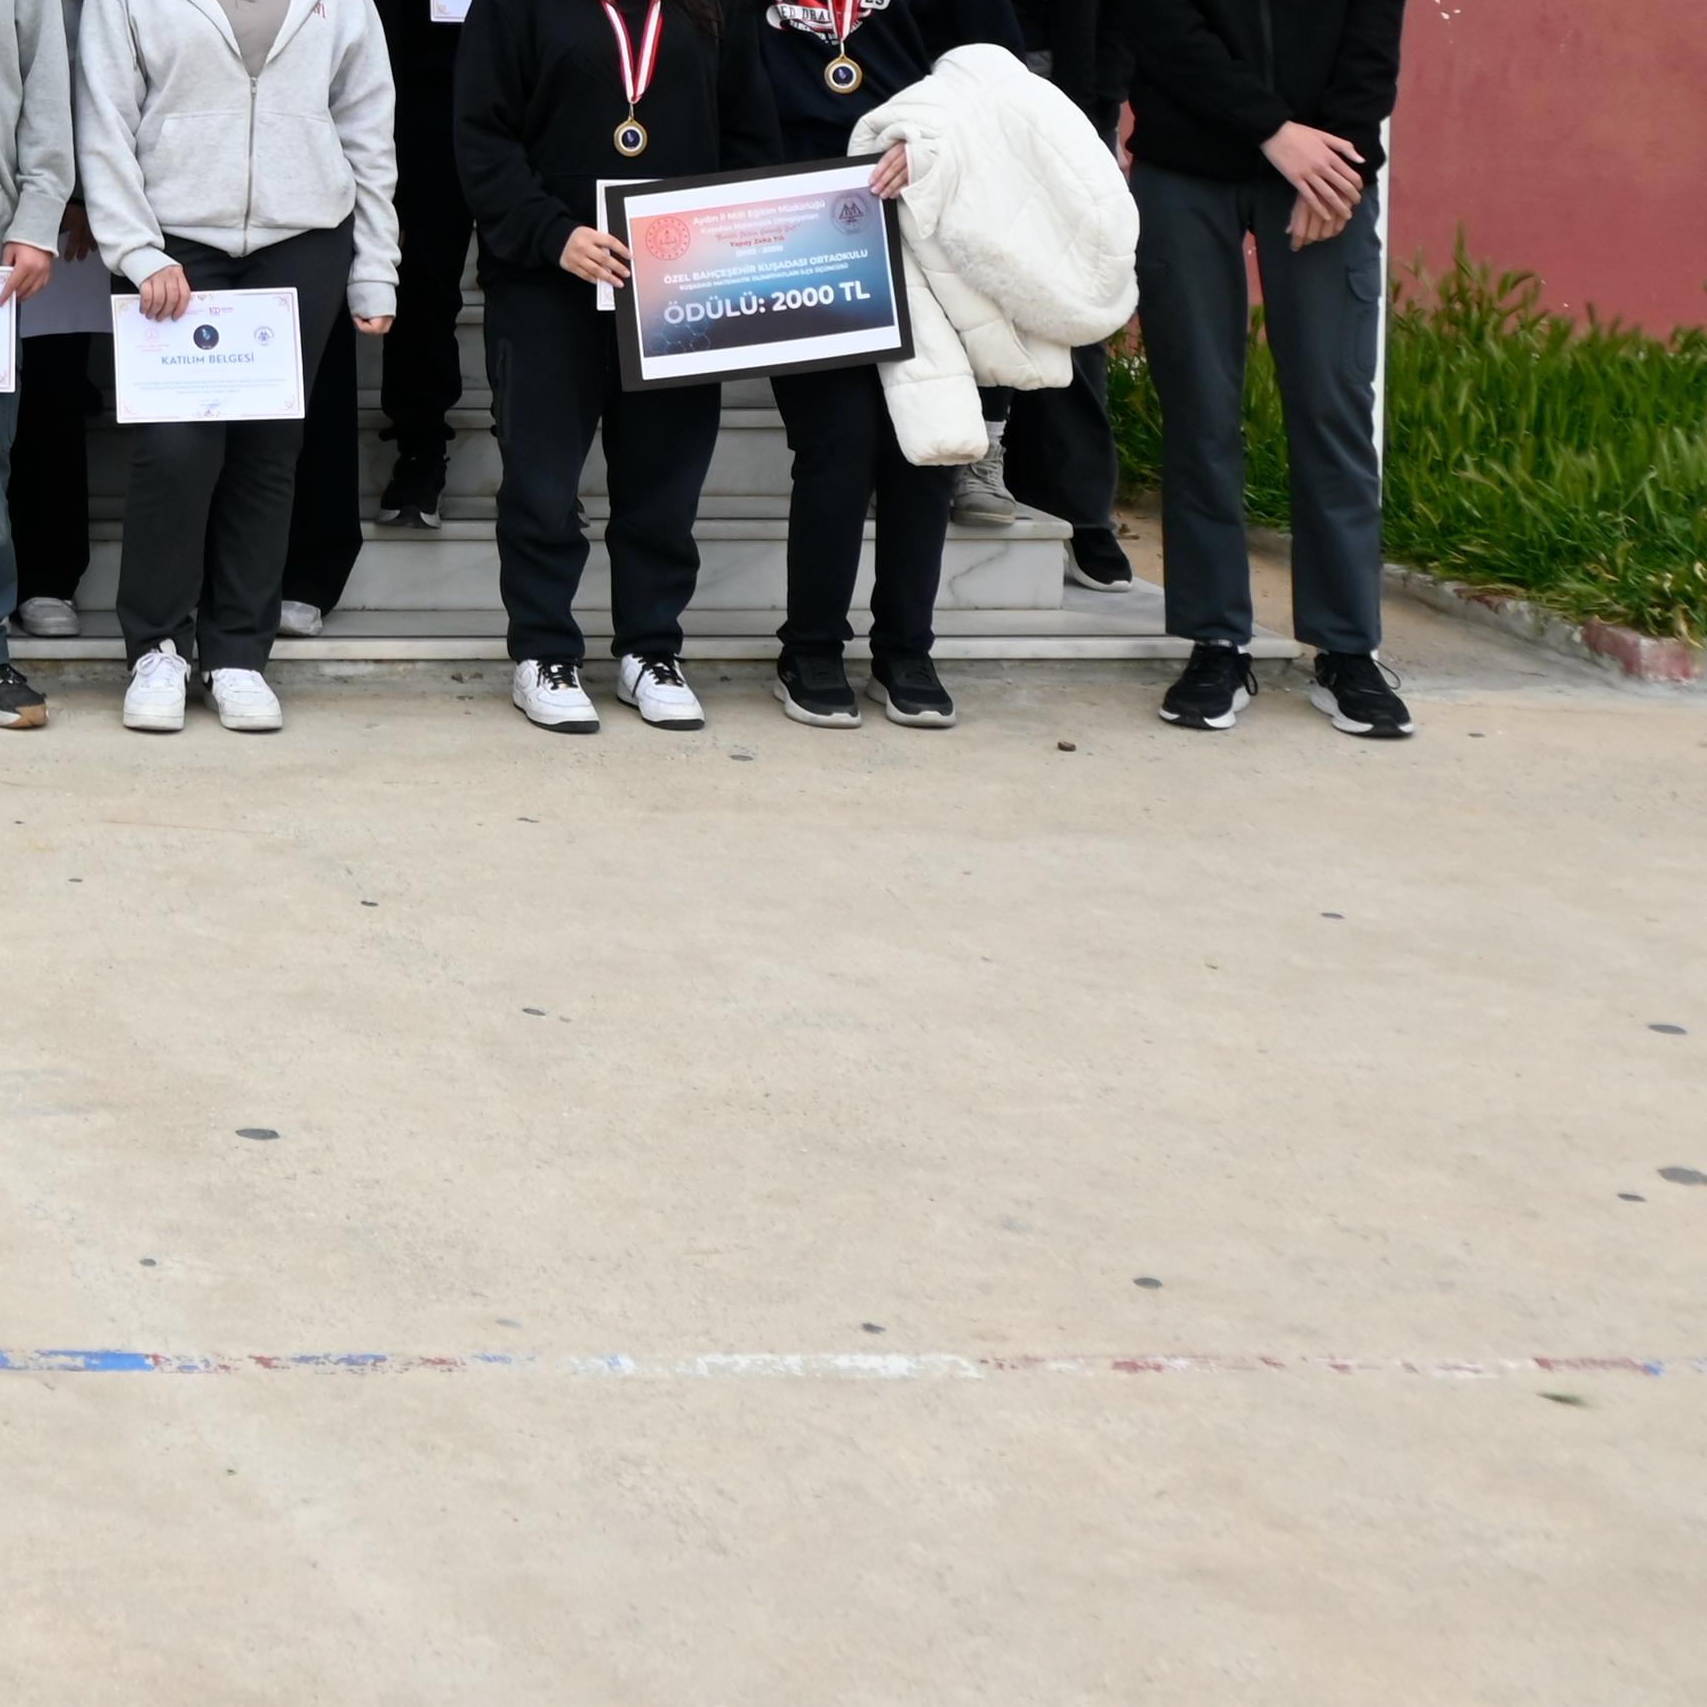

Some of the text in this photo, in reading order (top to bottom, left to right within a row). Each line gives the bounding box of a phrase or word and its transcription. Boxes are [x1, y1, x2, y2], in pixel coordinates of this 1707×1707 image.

[663, 280, 871, 325] ÖDÜLÜ: 2000 TL
[161, 355, 205, 365] KATILIM
